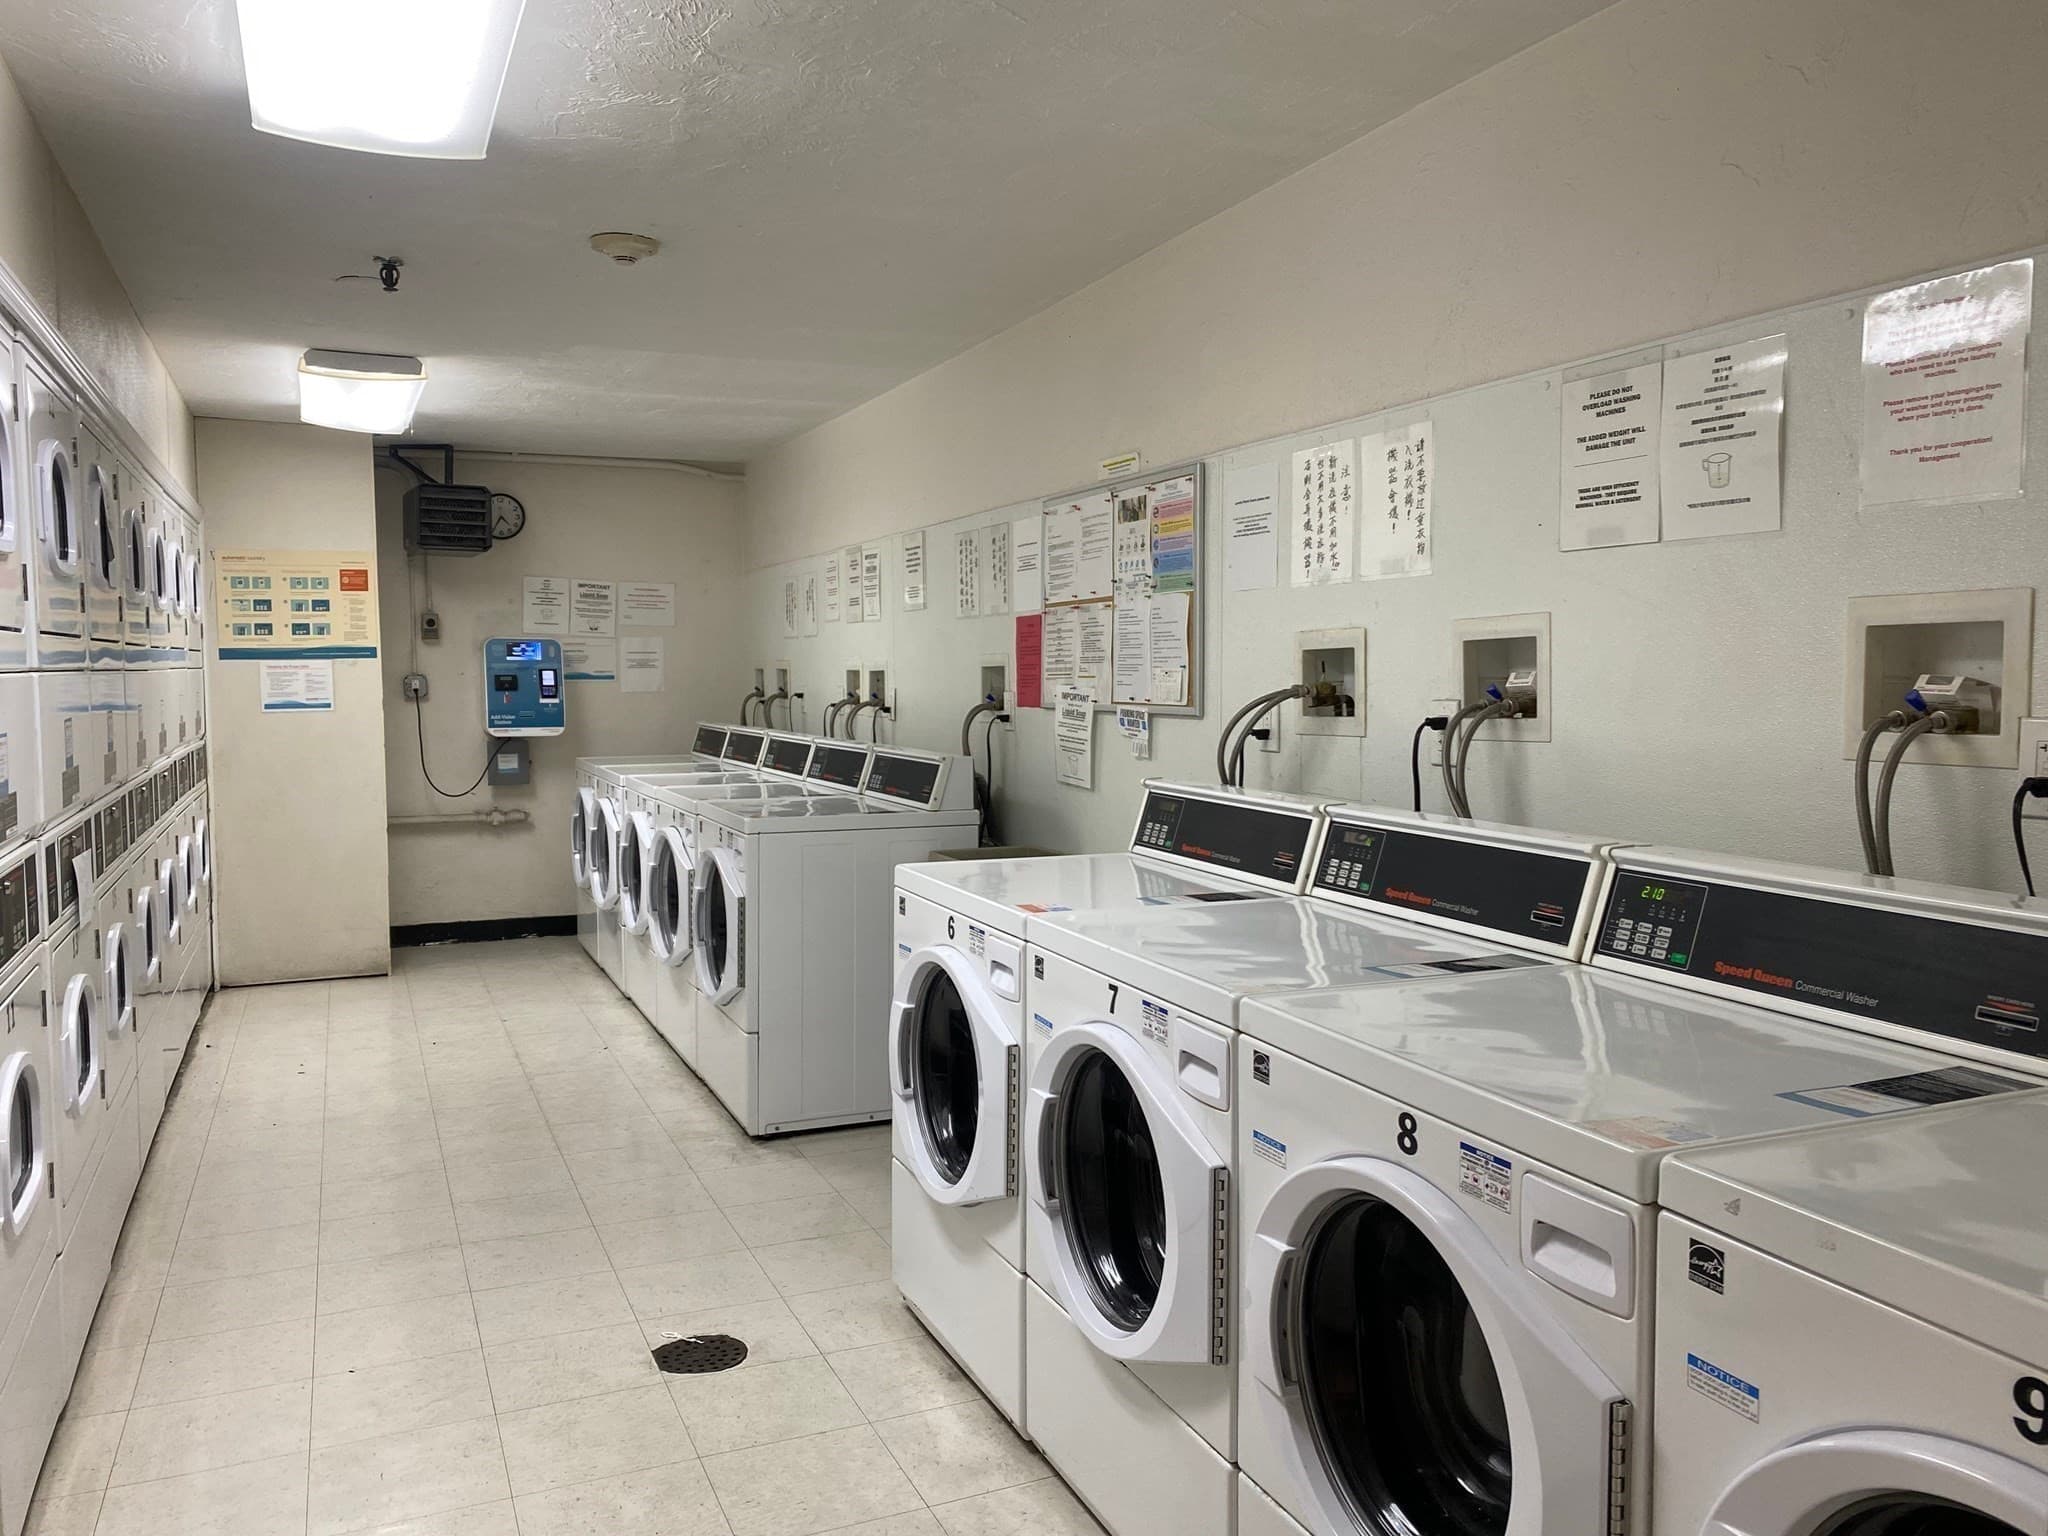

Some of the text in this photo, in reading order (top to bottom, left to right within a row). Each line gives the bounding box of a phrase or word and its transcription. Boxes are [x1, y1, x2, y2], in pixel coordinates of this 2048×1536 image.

[1951, 349, 1966, 357] your
[1589, 385, 1633, 400] PLEASE DO NOT
[1930, 392, 1945, 400] your
[1582, 394, 1641, 411] OVERLOAD WASHING
[1890, 408, 1905, 416] your
[1944, 399, 1961, 407] dryer
[1596, 407, 1626, 417] MACHINES
[1915, 413, 1930, 421] your
[1588, 433, 1607, 442] ADDED
[1608, 428, 1630, 438] WEIGHT
[1631, 425, 1646, 434] WILL
[1585, 437, 1636, 452] DAMAGE THE UNIT
[1934, 443, 1949, 451] your
[1919, 452, 1960, 462] Management
[1061, 691, 1090, 703] IMPORTANT
[1641, 886, 1665, 900] 210
[947, 915, 955, 940] 6
[1714, 961, 1879, 1007] Speed Queen Commercial Washer
[1108, 983, 1119, 1014] 7
[1397, 1111, 1418, 1156] 8
[1697, 1359, 1751, 1394] NOTICE
[2012, 1376, 2048, 1446] 9
